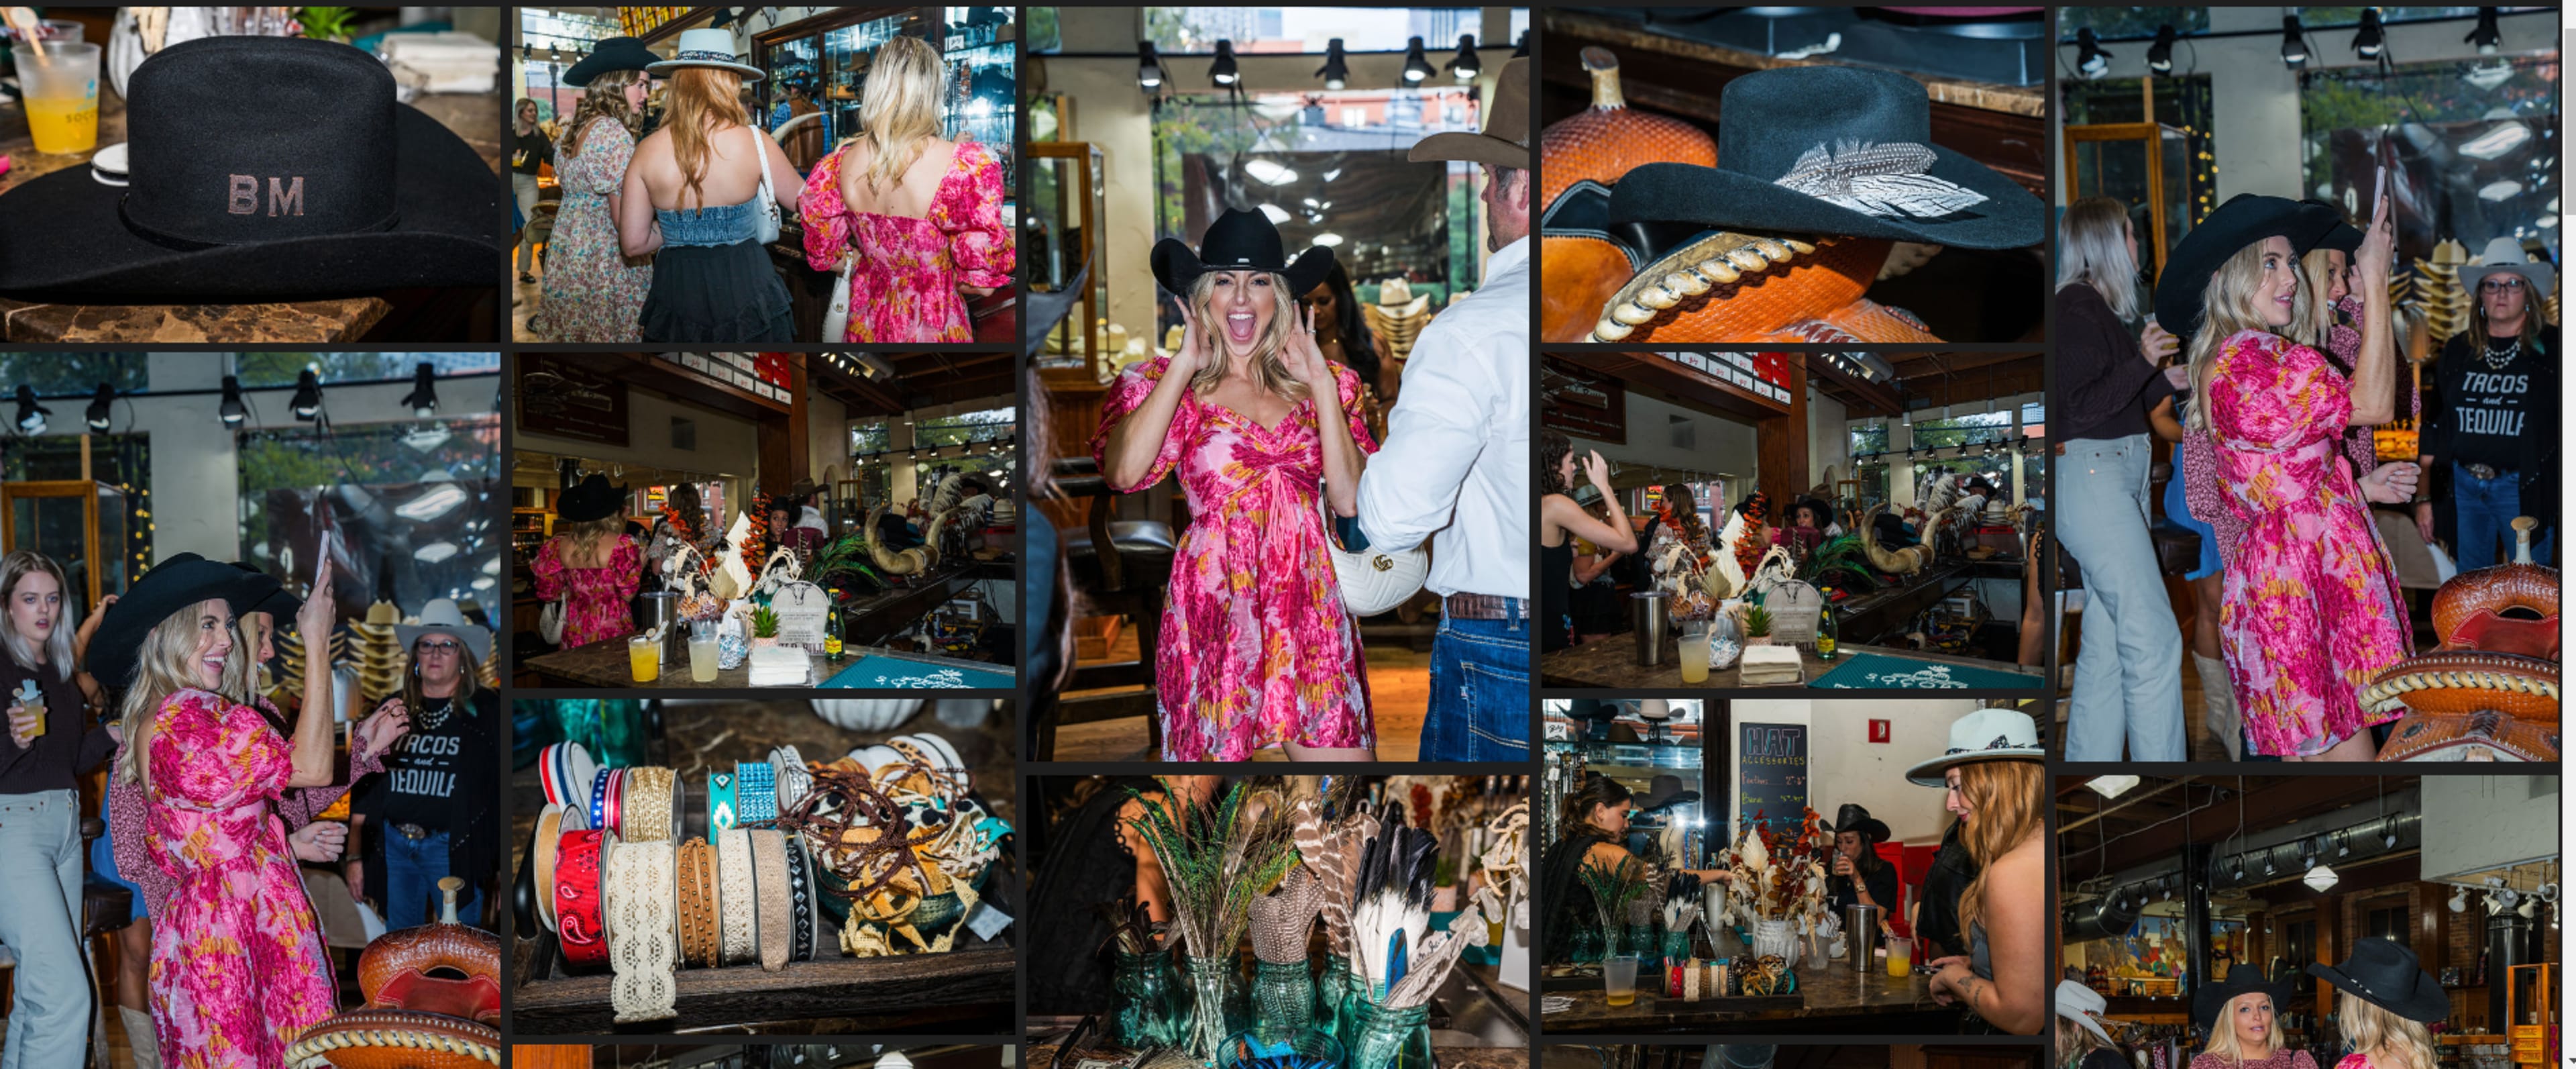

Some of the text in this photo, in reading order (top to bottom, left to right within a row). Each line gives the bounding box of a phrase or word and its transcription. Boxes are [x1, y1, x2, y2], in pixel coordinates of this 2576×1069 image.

[228, 174, 304, 217] BM
[2462, 372, 2528, 393] TACOS
[2483, 396, 2503, 405] and
[395, 734, 460, 755] TACOS
[1746, 727, 1801, 757] HAT
[1742, 756, 1805, 766] ACCESSORIES
